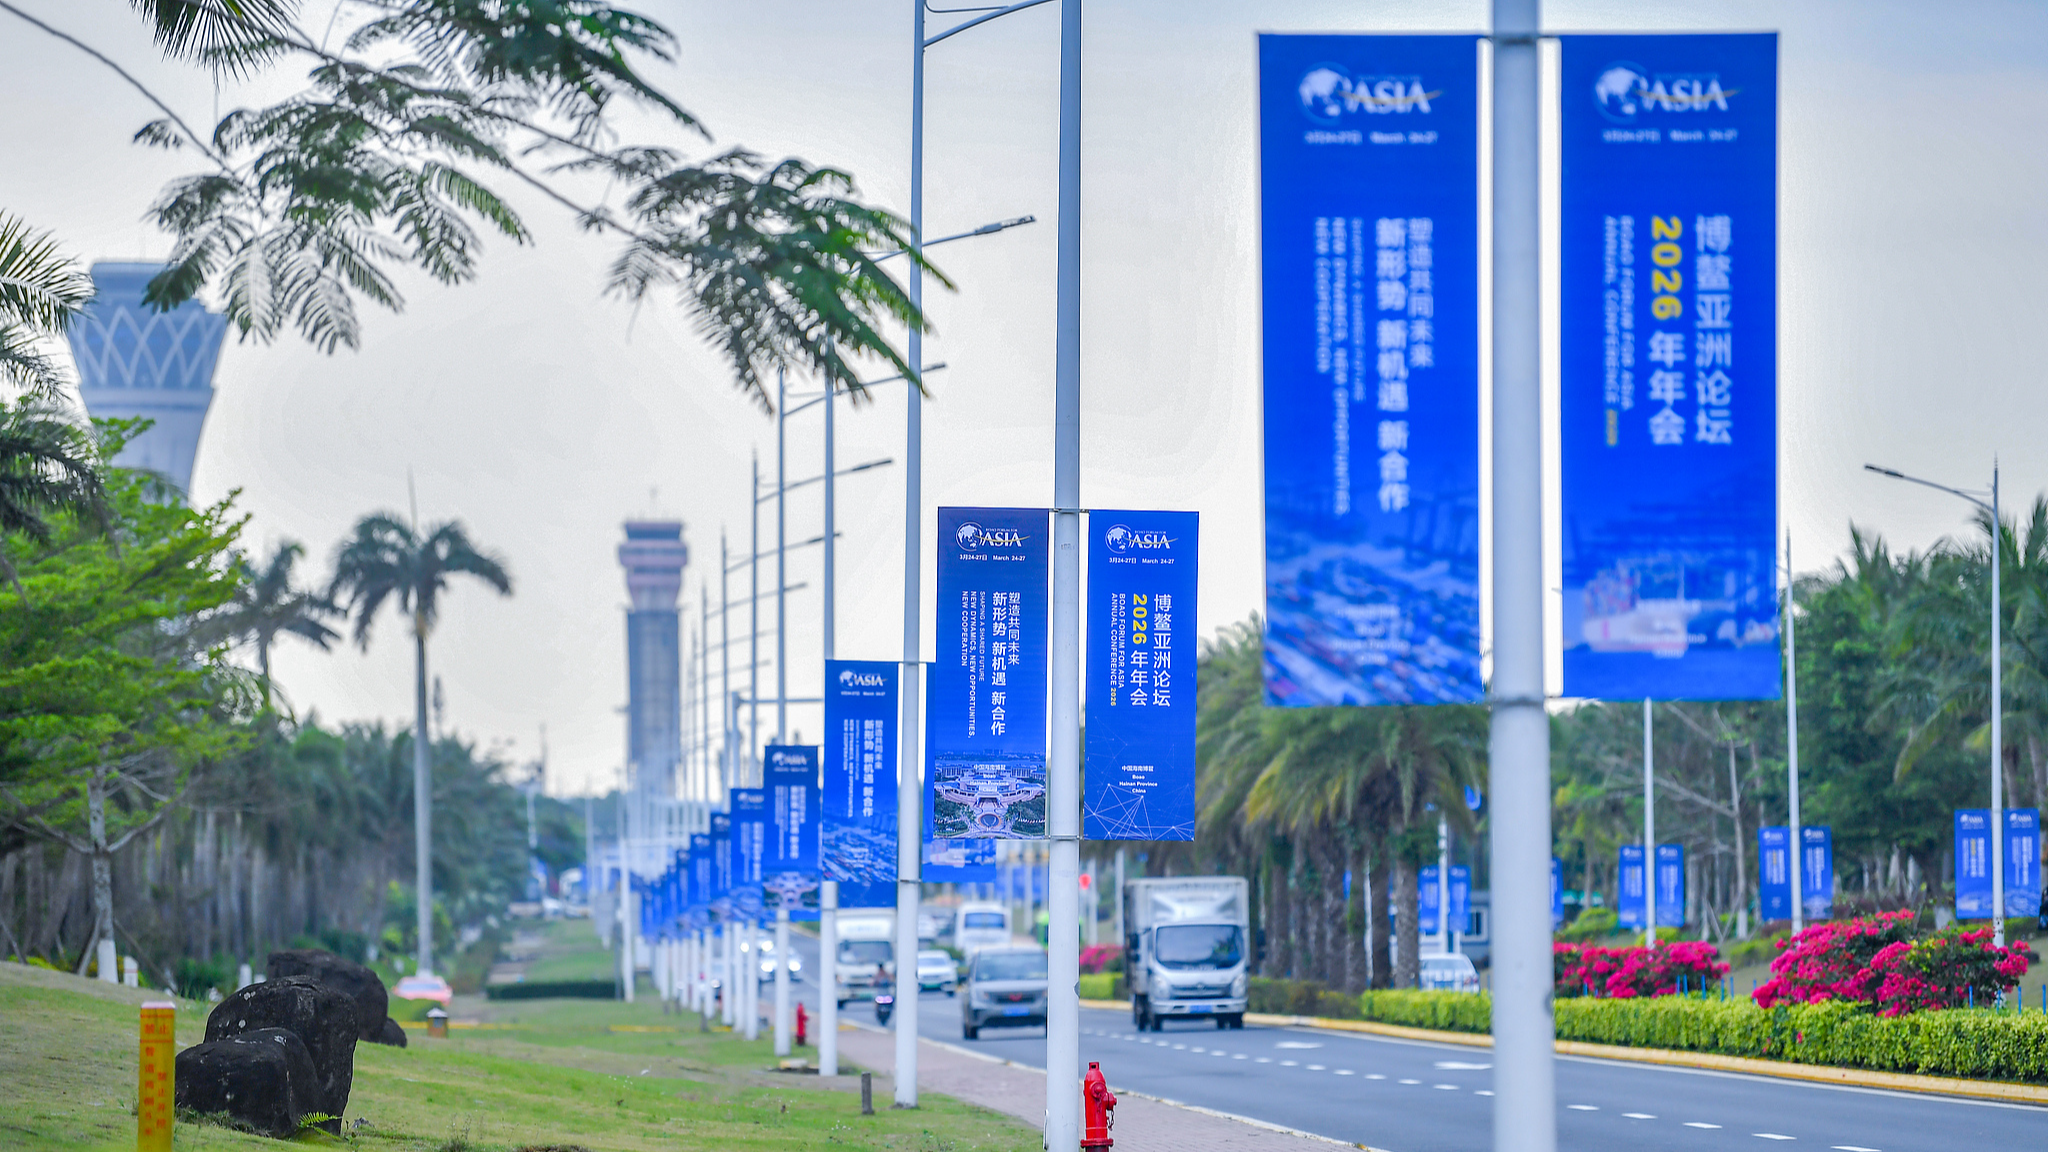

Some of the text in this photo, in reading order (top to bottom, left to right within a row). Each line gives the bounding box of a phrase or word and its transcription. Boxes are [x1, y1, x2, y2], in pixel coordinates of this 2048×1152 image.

[1346, 80, 1432, 114] ASIA
[1642, 78, 1729, 112] ASIA
[1647, 214, 1687, 446] 2026 年年会
[1694, 214, 1732, 445] 博鳌亚洲论坛
[1377, 420, 1410, 513] 新合作
[982, 531, 1022, 547] ASIA
[1130, 533, 1171, 549] ASIA
[961, 590, 969, 609] NEW
[1110, 592, 1118, 628] ANNUAL
[969, 610, 977, 653] DYNAMICS,
[1008, 591, 1021, 666] 塑造共同未来
[1118, 618, 1126, 649] FORUM
[1130, 593, 1149, 707] 2026 年年会
[1152, 593, 1172, 707] 博鳌亚洲论坛
[991, 591, 1007, 736] 新形势 新机遇 新合作
[1110, 629, 1118, 687] CONFERENCE
[1117, 668, 1125, 689] ASIA
[854, 674, 884, 687] ASIA
[968, 674, 976, 739] OPPORTUNITIES,
